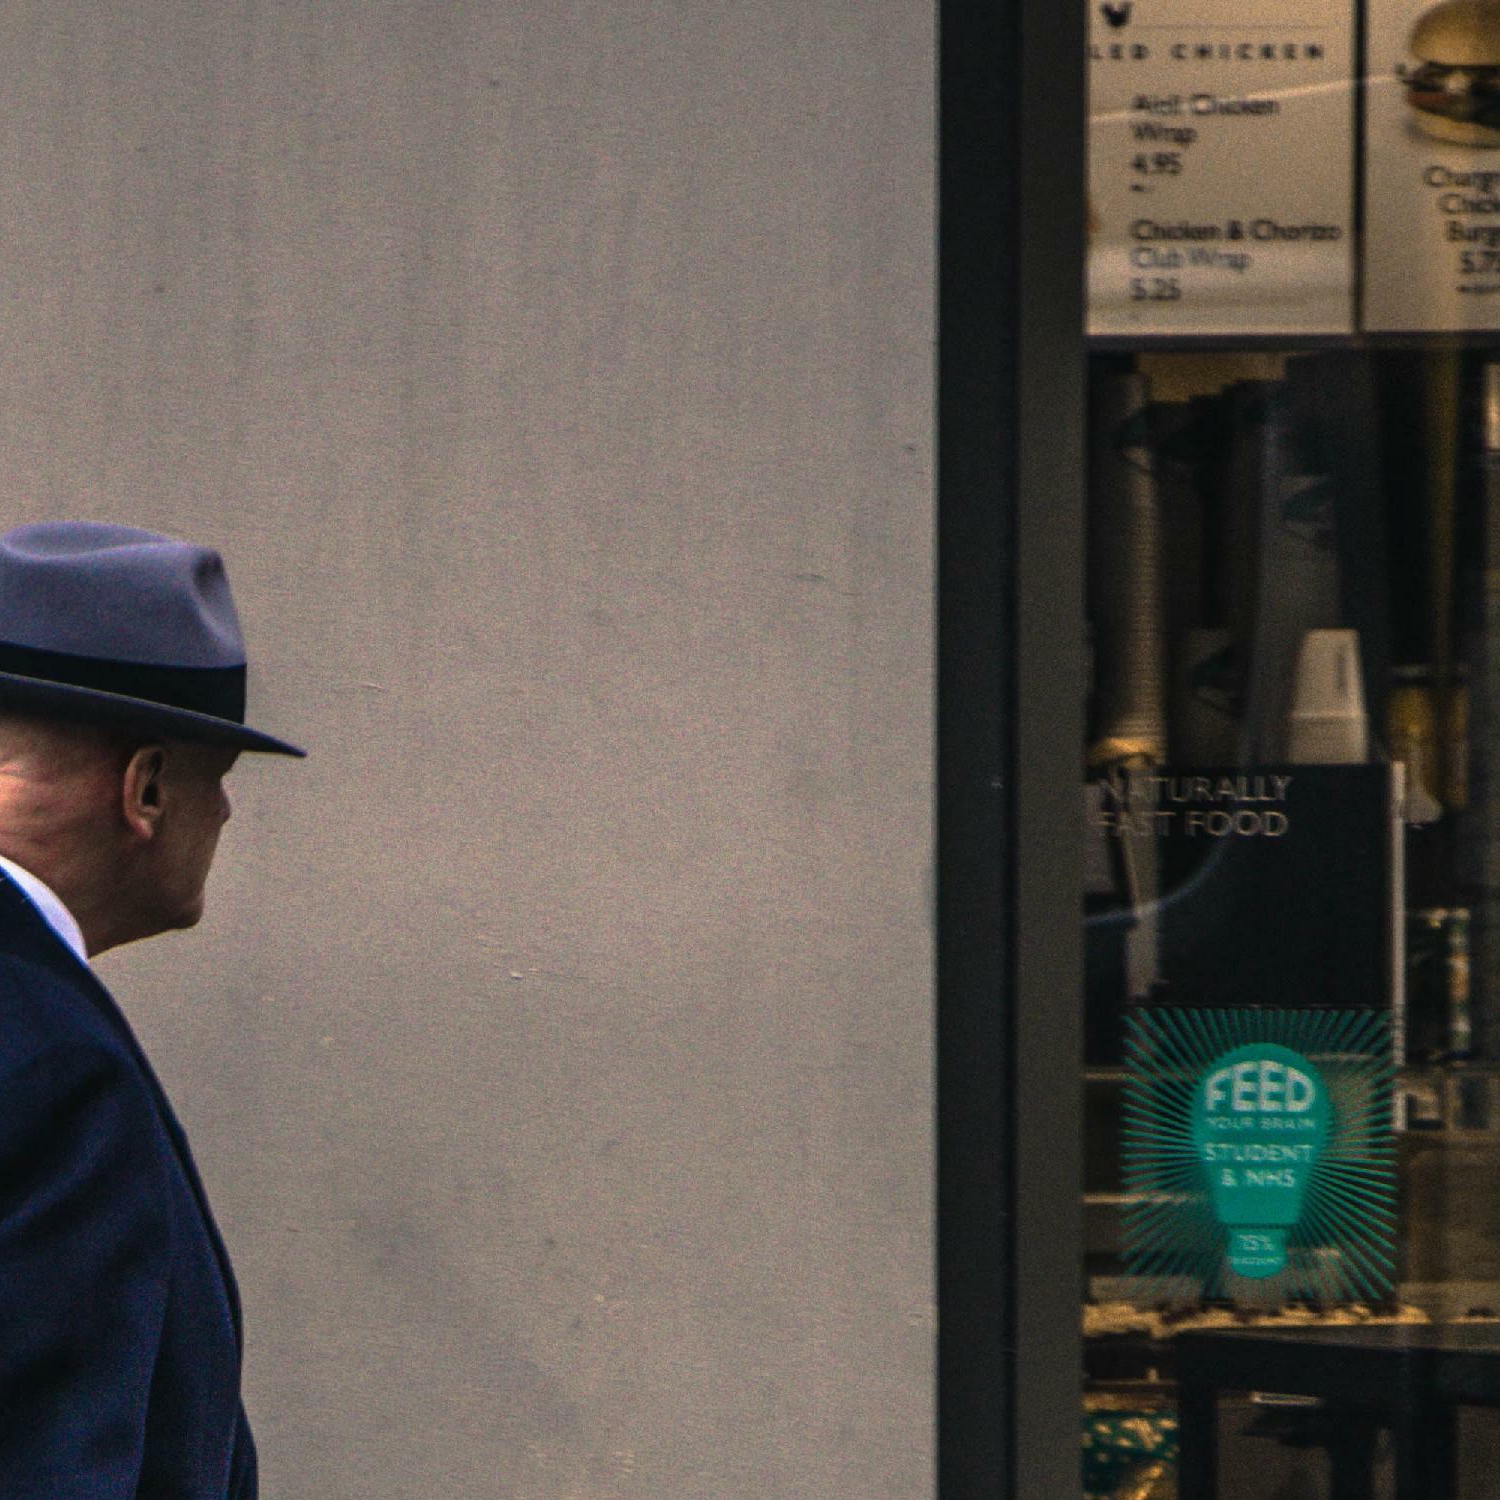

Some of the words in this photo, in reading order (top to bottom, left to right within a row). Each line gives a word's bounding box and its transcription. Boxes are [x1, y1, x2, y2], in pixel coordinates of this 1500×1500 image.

[1171, 43, 1323, 60] CHICKEN
[1131, 122, 1197, 147] Wrap
[1130, 218, 1220, 241] Chicken
[1251, 218, 1342, 241] Chorizo
[1187, 247, 1250, 274] Wrap
[1186, 810, 1288, 837] FOOD
[1205, 1060, 1315, 1112] FEED
[1206, 1117, 1253, 1129] YOUR
[1260, 1117, 1316, 1129] BRAIN
[1204, 1143, 1313, 1161] STUDENT
[1220, 1168, 1237, 1187] &
[1245, 1168, 1296, 1187] NHS
